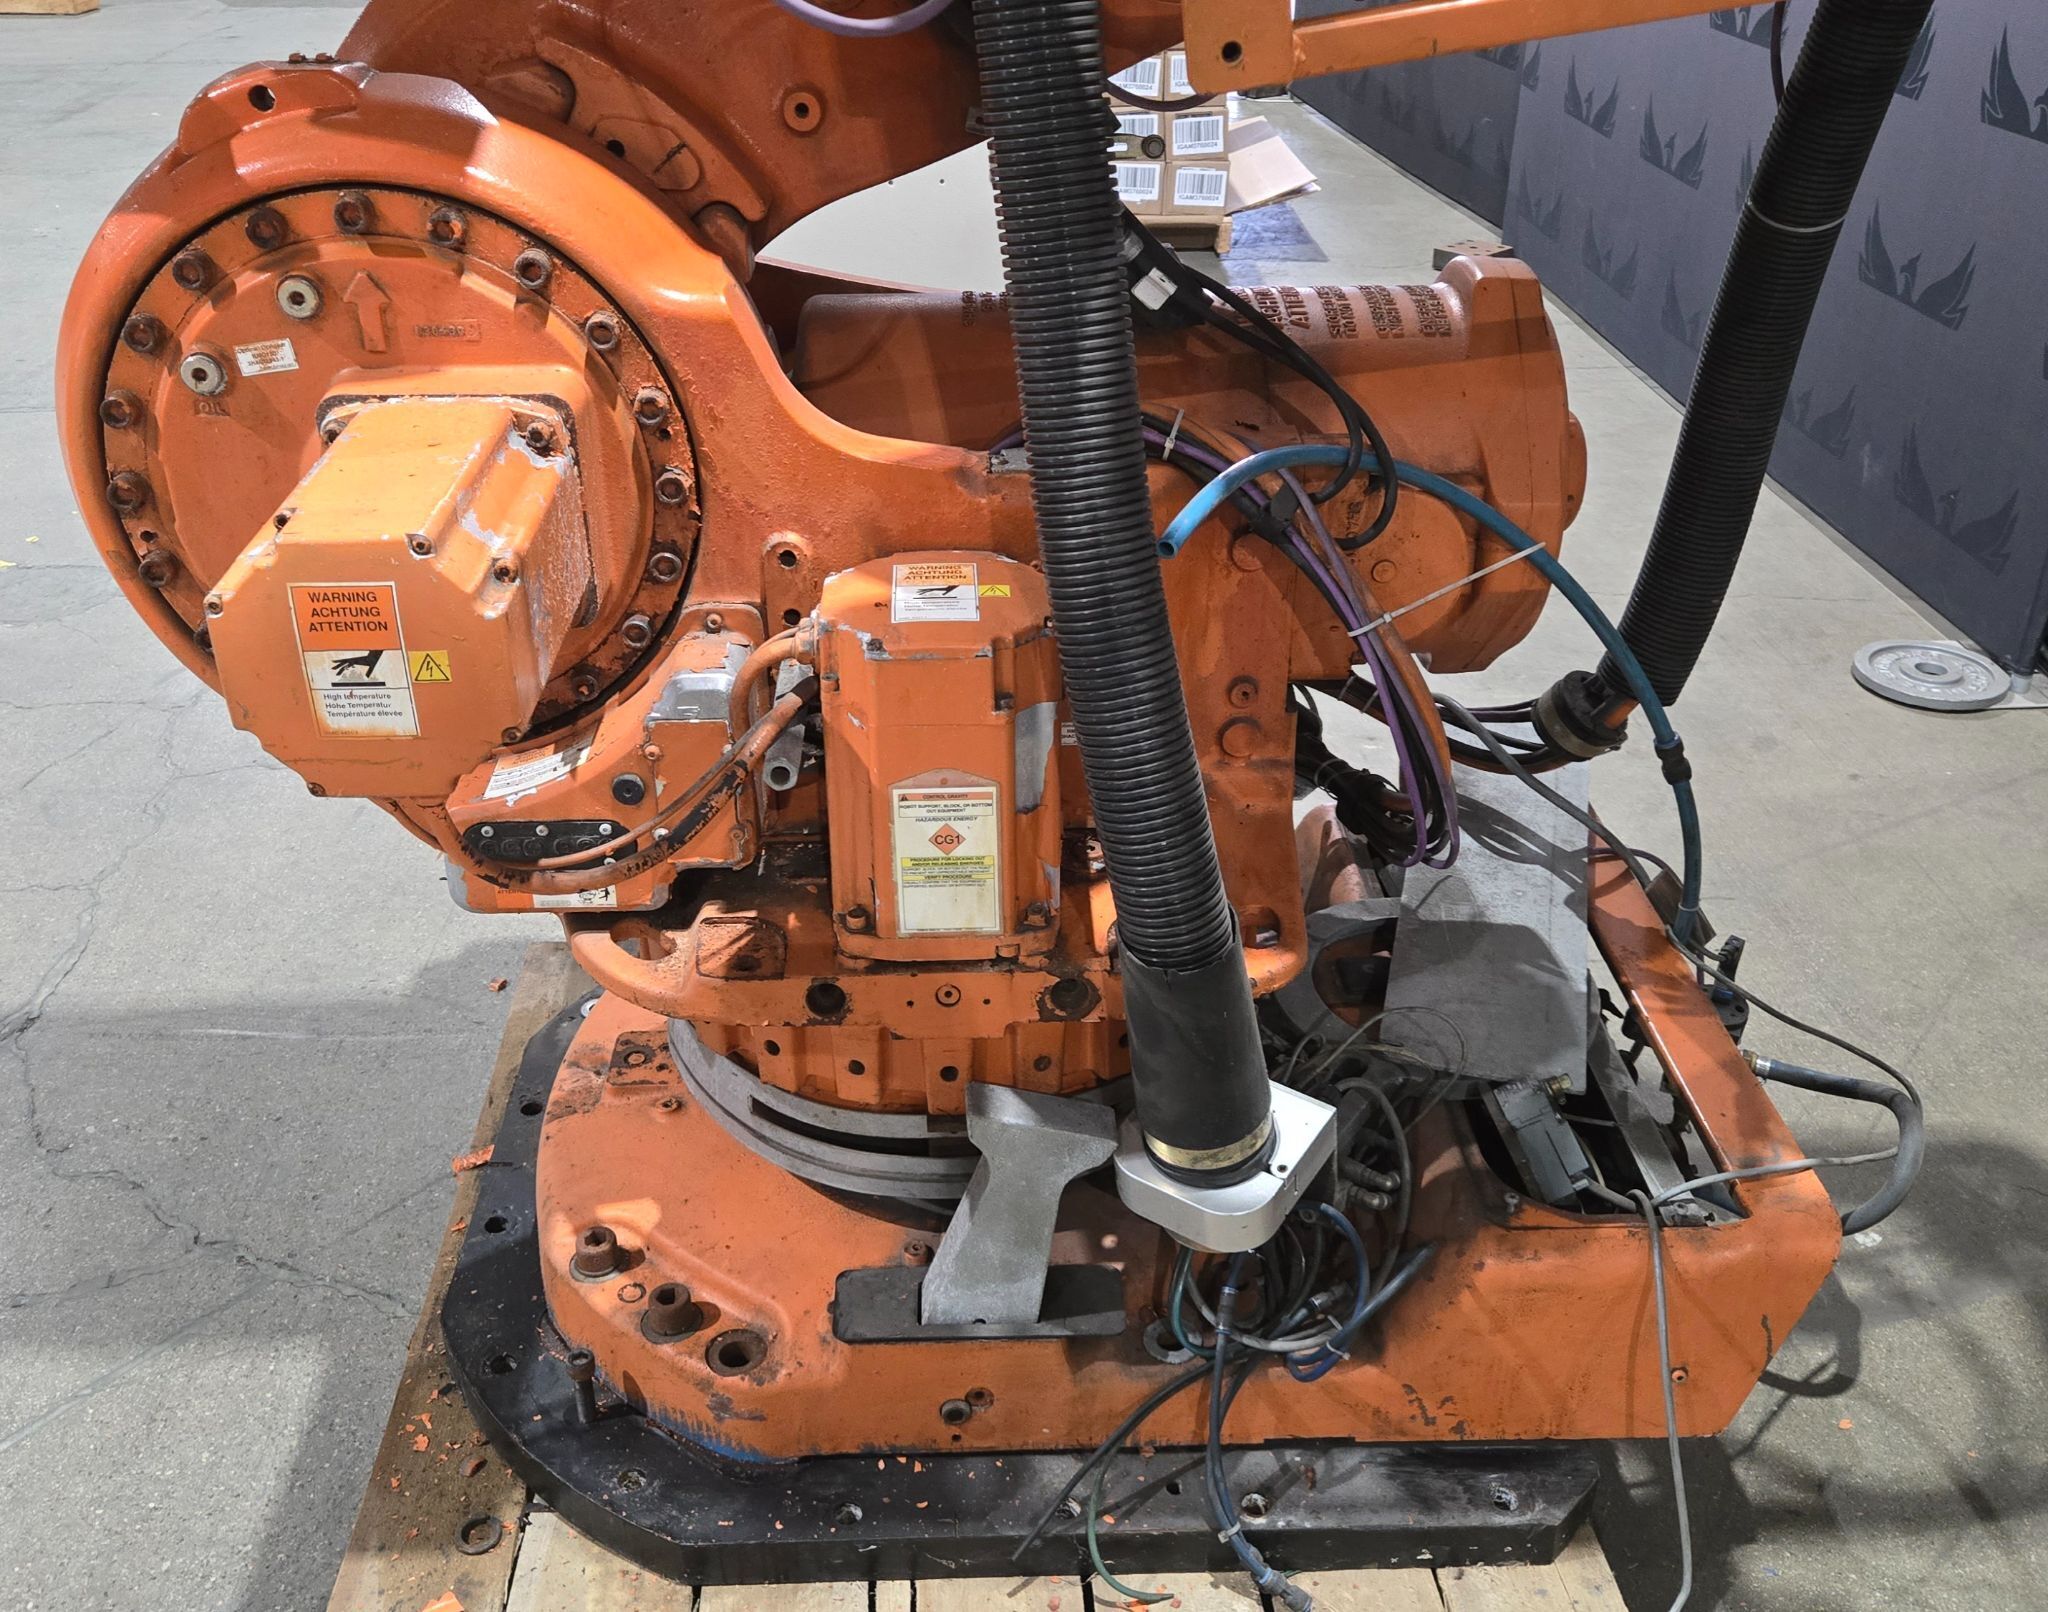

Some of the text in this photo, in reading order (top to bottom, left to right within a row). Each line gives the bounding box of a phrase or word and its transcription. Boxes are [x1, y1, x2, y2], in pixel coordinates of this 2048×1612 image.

[307, 591, 378, 604] WARNING
[310, 606, 381, 618] ACHTUNG
[308, 621, 389, 633] ATTENTION
[323, 691, 392, 702] High temperature
[347, 701, 392, 711] Temperatur
[934, 834, 961, 845] CG1
